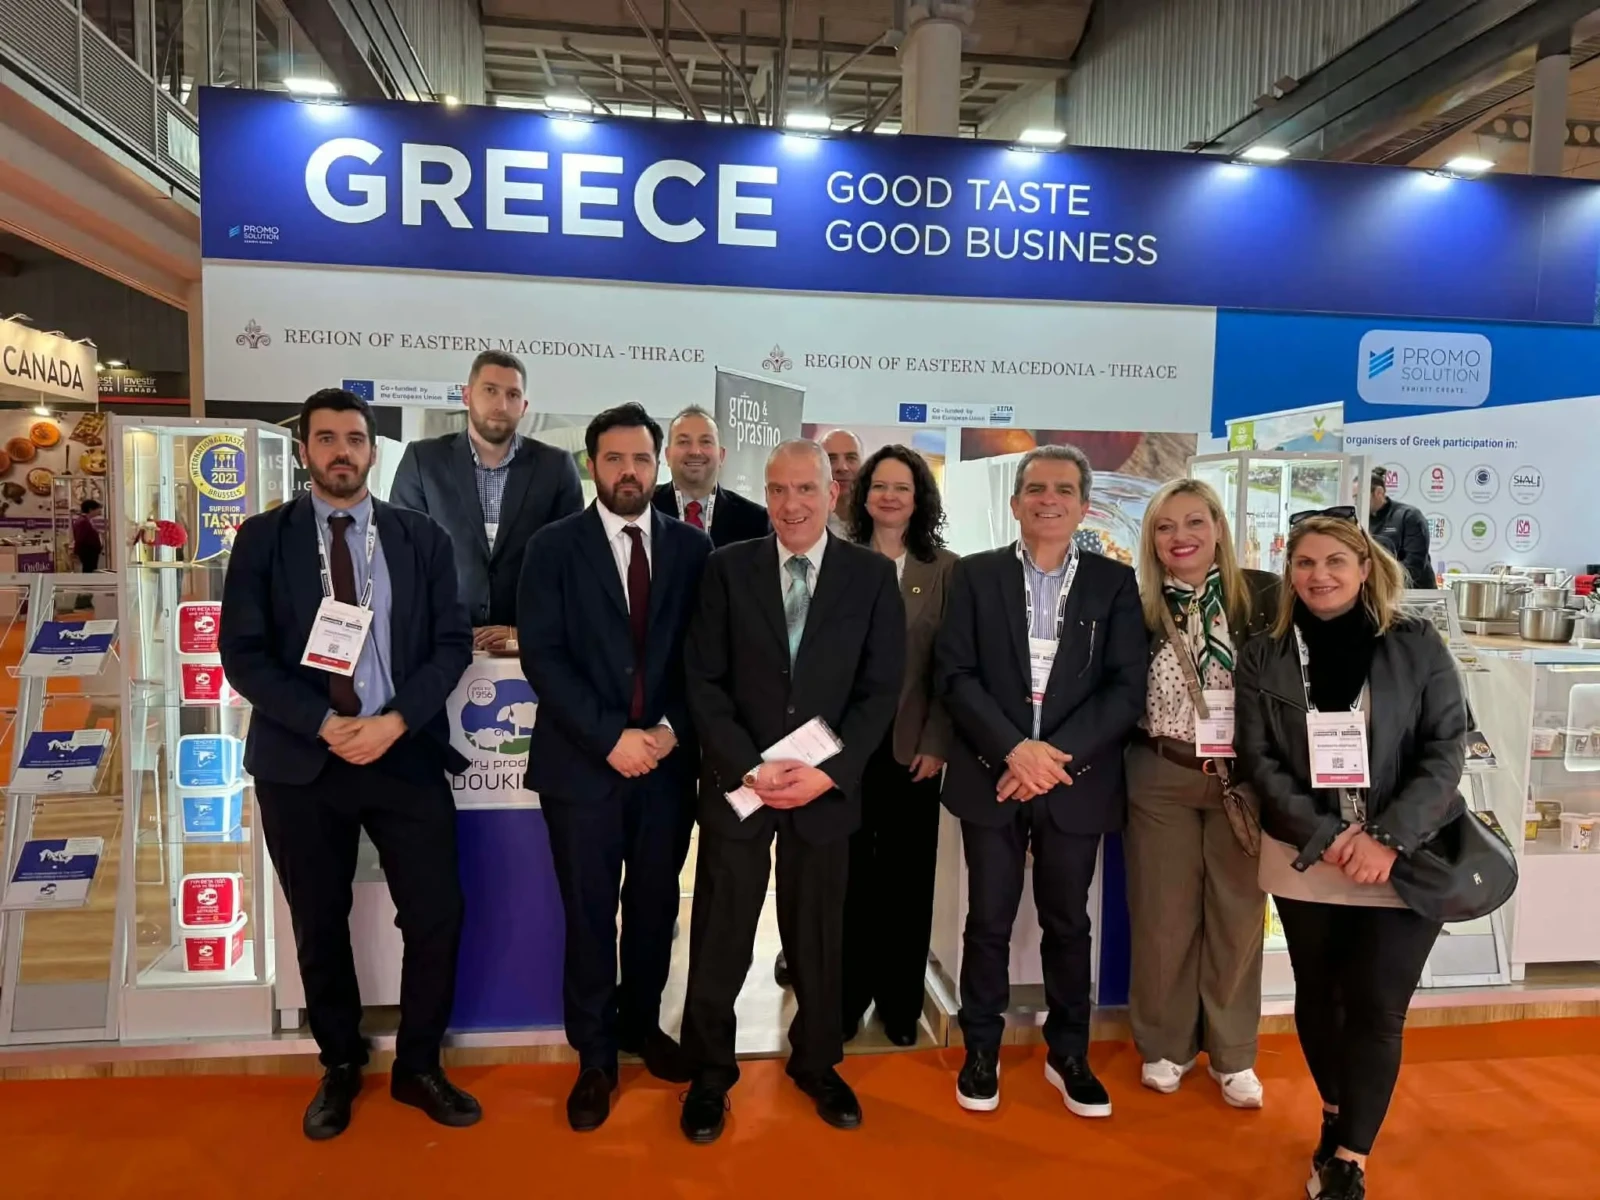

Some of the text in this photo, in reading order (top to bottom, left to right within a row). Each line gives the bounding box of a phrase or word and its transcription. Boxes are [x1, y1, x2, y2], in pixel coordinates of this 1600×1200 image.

[305, 137, 778, 248] GREECE
[826, 171, 1091, 216] GOOD TASTE
[243, 224, 280, 235] PROMO
[243, 232, 280, 241] SOLUTION
[825, 219, 1159, 266] GOOD BUSINESS
[284, 328, 362, 346] REGION
[368, 331, 395, 348] OF
[401, 334, 491, 351] EASTERN
[499, 339, 615, 359] MACEDONIA
[628, 345, 705, 363] THRACE
[804, 353, 873, 371] REGION
[878, 356, 901, 371] OF
[906, 357, 986, 374] EASTERN
[991, 360, 1095, 377] MACEDONIA
[1108, 363, 1177, 380] THRACE
[1403, 347, 1481, 368] PROMO
[3, 345, 84, 392] CANADA
[1401, 366, 1480, 383] SOLUTION
[737, 420, 781, 452] prasino
[1345, 434, 1518, 450] organisers of Greek participation in:
[211, 472, 238, 484] 2021
[207, 488, 244, 499] BRUSSELS
[208, 505, 241, 513] SUPERIOR
[472, 691, 492, 699] 1956
